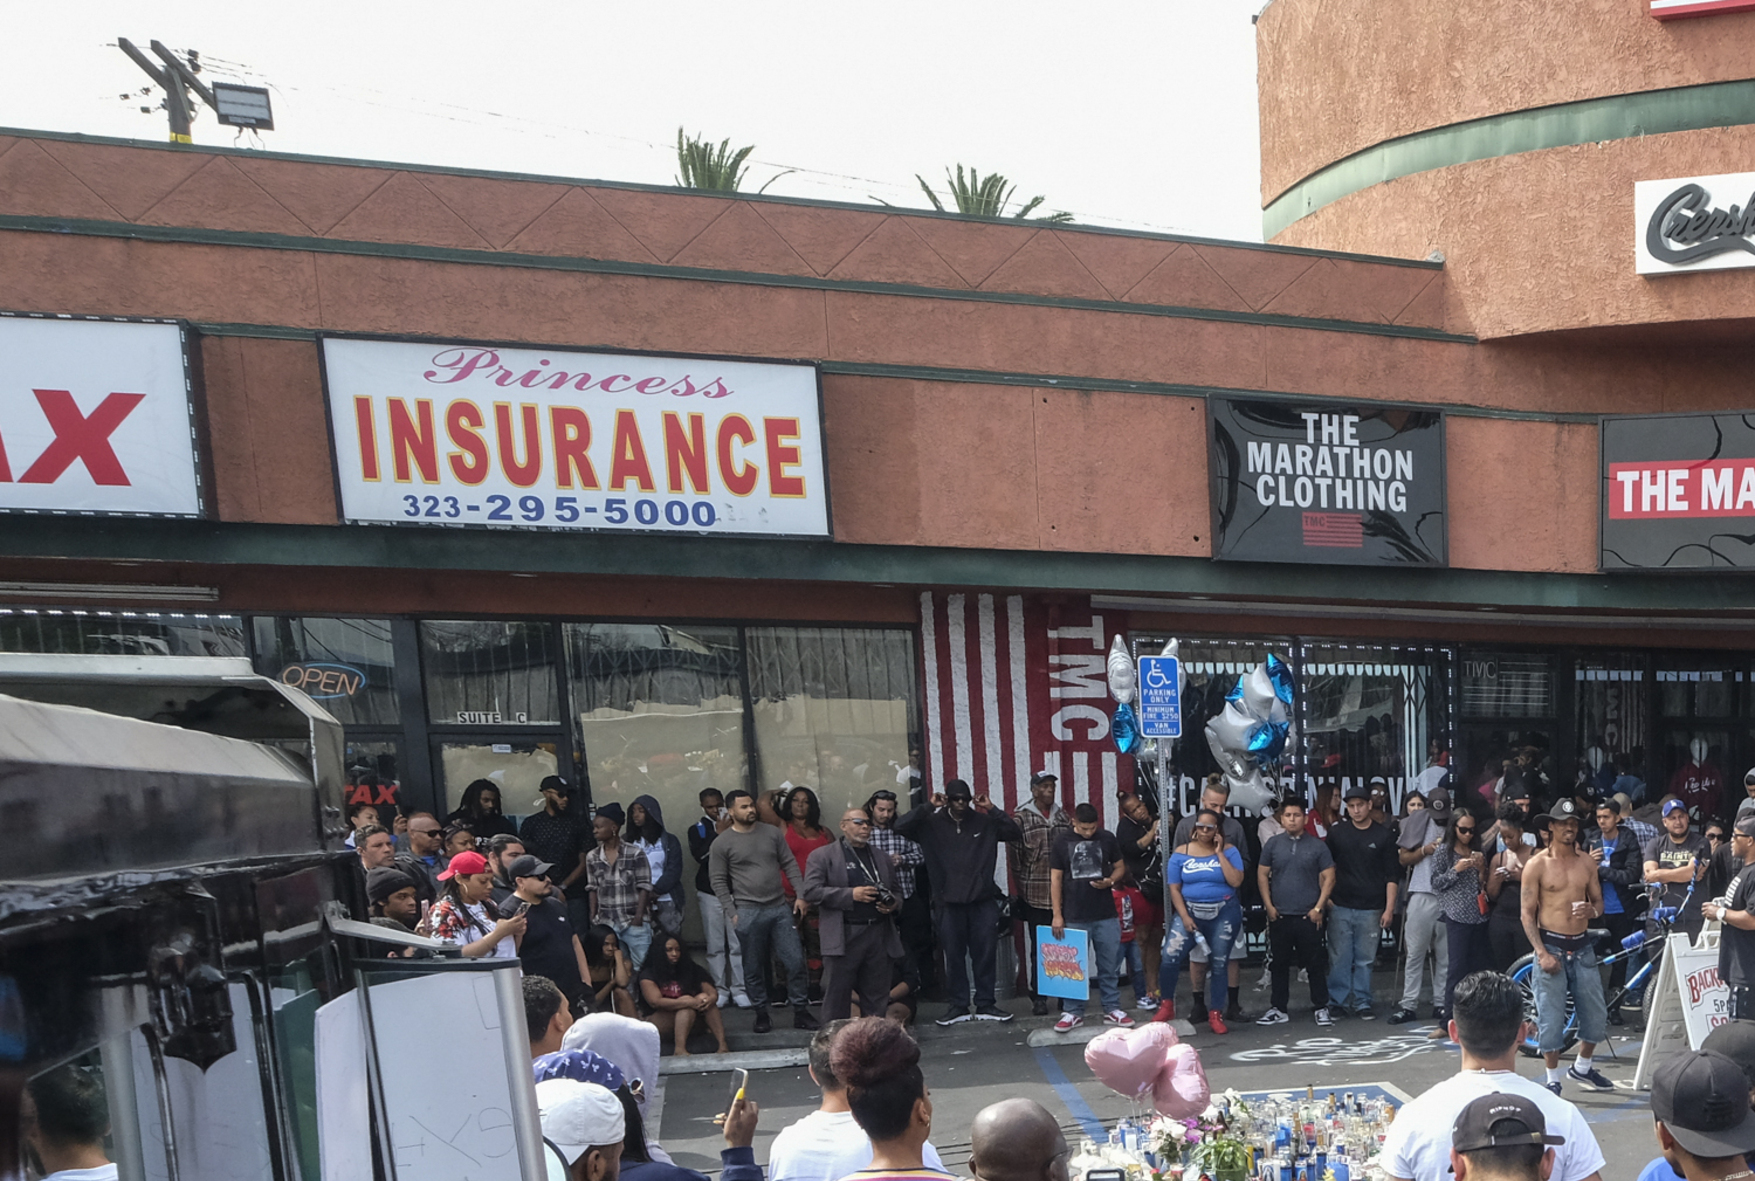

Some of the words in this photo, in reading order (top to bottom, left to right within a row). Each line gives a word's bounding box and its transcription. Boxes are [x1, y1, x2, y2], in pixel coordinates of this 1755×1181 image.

[423, 347, 734, 399] Princess
[0, 389, 147, 486] X
[353, 394, 807, 499] INSURANCE
[1301, 412, 1359, 446] THE
[1247, 441, 1413, 480] MARATHON
[1256, 474, 1407, 512] CLOTHING
[1617, 469, 1689, 512] THE
[403, 494, 717, 527] 323-295-5000
[1304, 515, 1326, 527] TMC
[282, 666, 360, 695] OPEN
[1047, 615, 1110, 741] TMC
[1464, 660, 1496, 679] TMC
[458, 712, 500, 724] SUITE
[517, 713, 526, 724] C
[1687, 966, 1725, 1003] BACK
